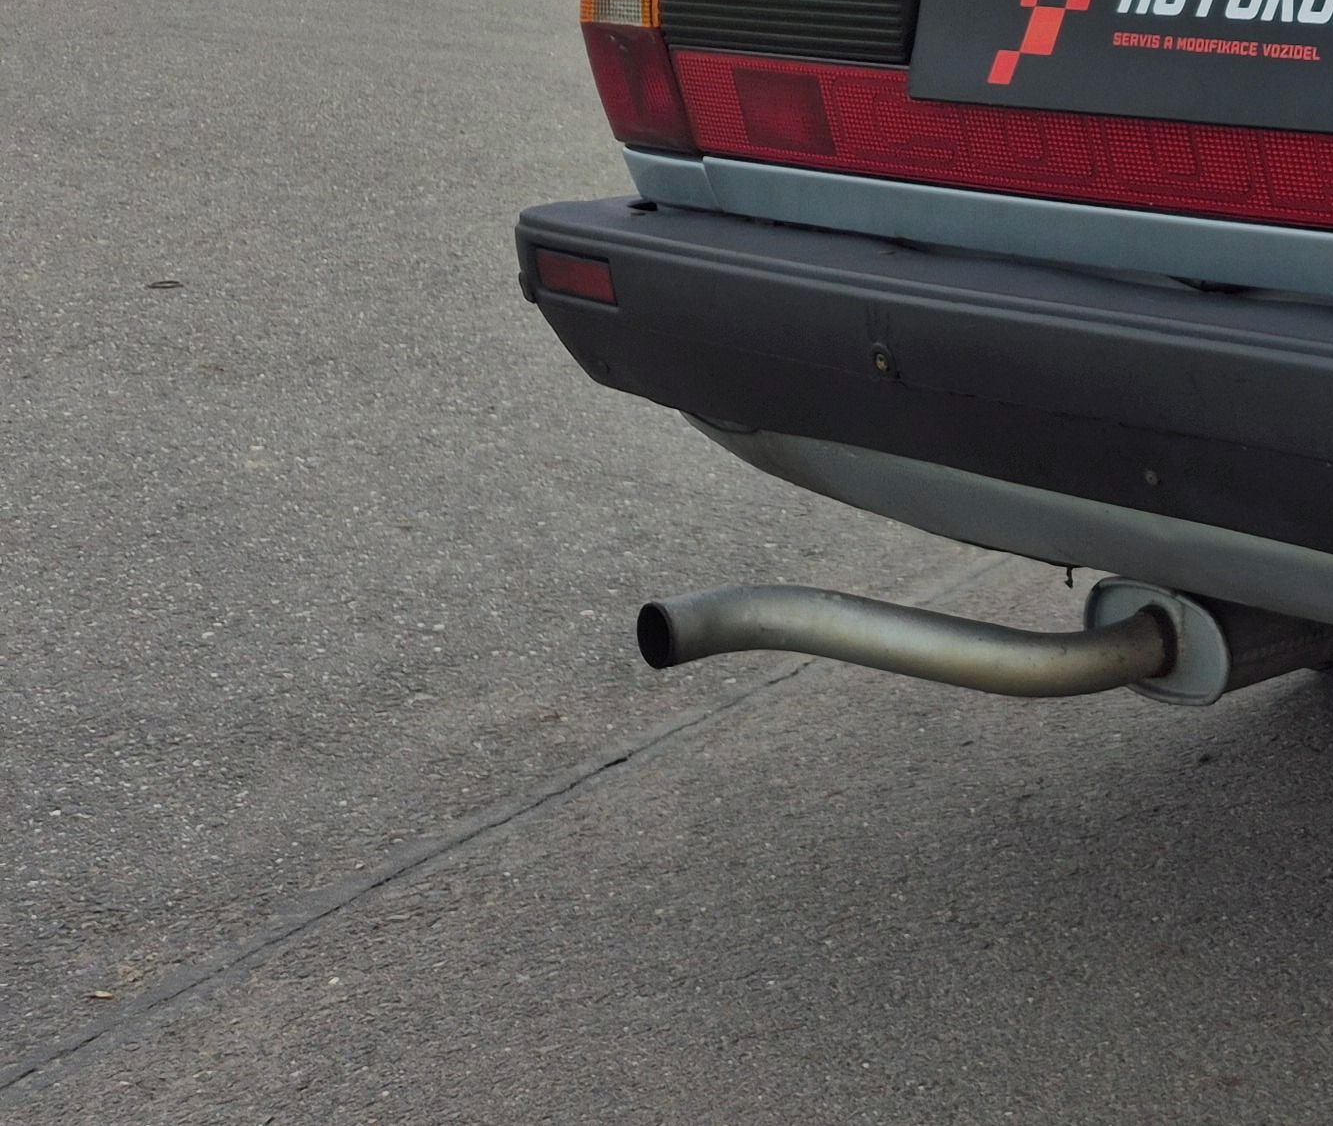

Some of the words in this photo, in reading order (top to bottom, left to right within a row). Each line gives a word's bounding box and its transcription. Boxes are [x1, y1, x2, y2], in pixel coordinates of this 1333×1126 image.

[1113, 32, 1160, 49] SERVIS
[1163, 37, 1173, 50] A
[1176, 37, 1258, 56] MODIFIKACE
[1263, 43, 1321, 61] VOZIDEL
